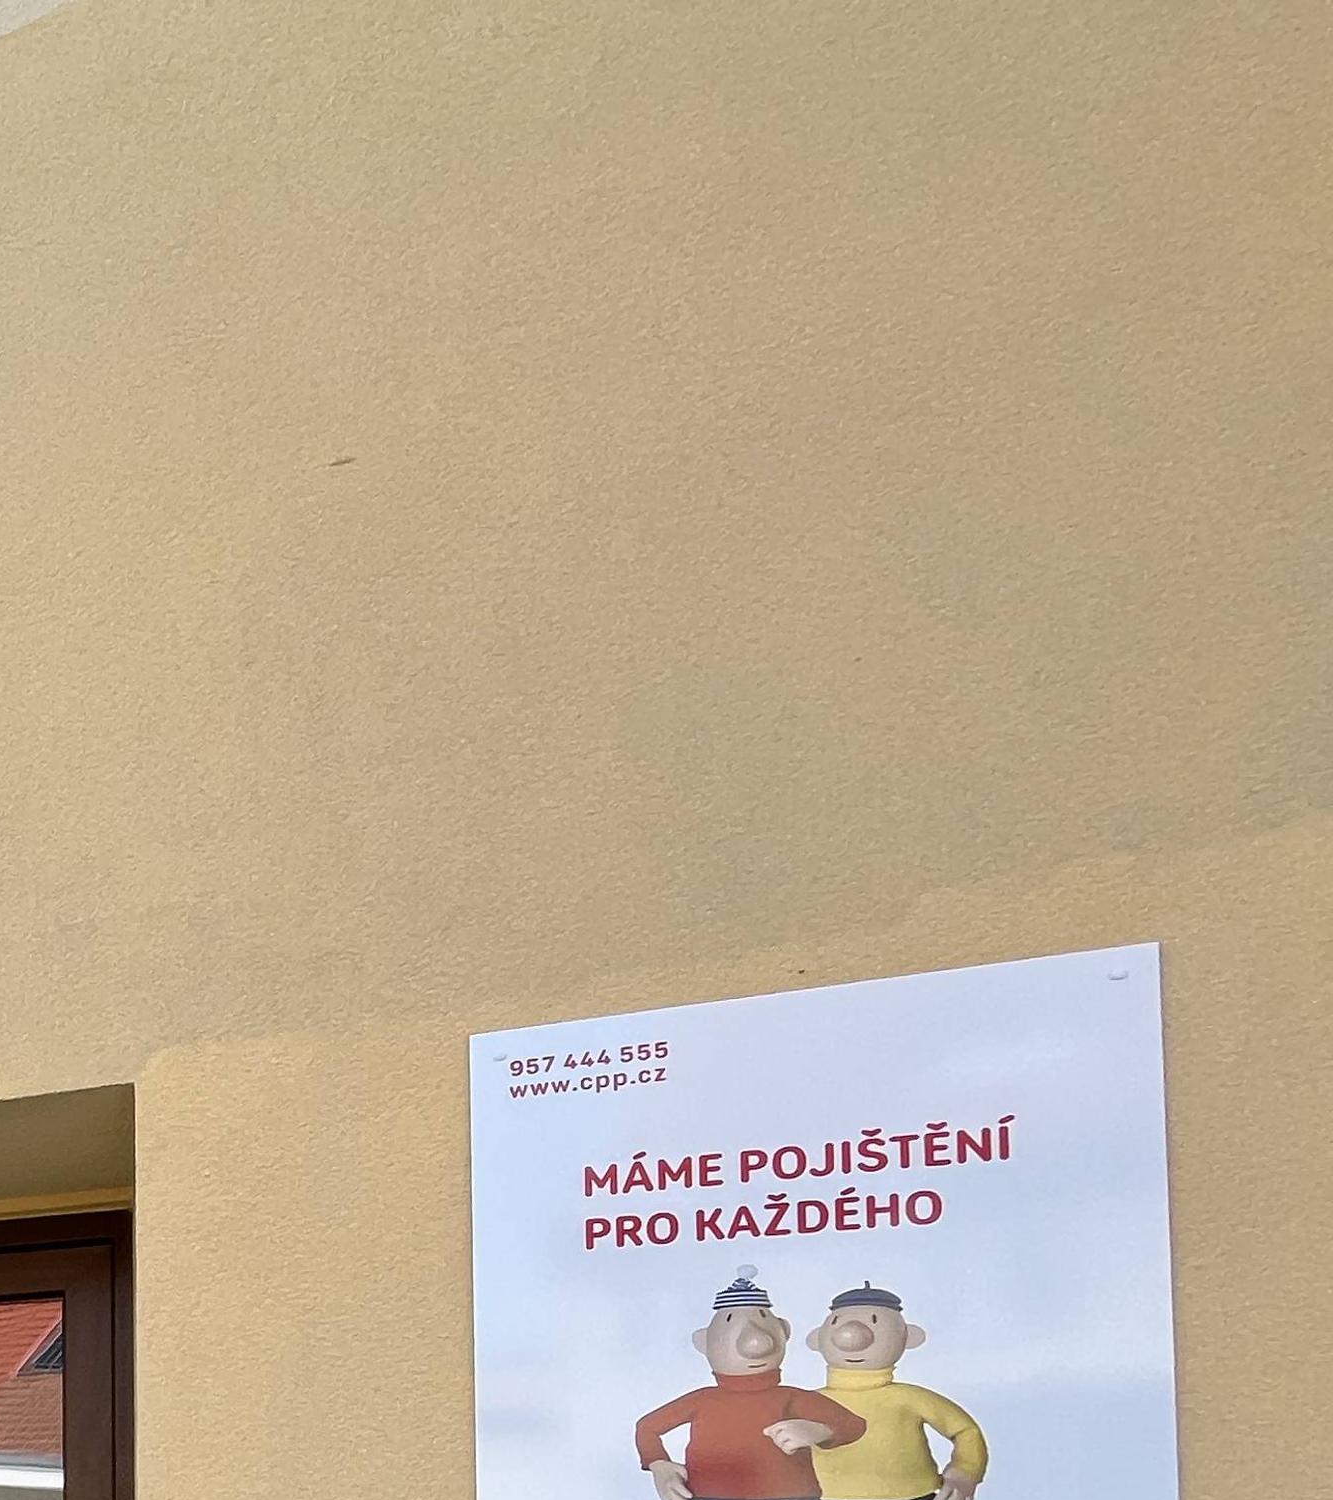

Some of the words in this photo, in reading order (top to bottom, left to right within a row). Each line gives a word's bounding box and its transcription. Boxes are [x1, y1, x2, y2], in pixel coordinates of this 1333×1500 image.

[510, 1056, 555, 1076] 957
[564, 1049, 611, 1069] 444
[620, 1041, 669, 1063] 555
[510, 1067, 667, 1098] www.cpp.cz
[583, 1151, 724, 1198] MÁME
[740, 1114, 1016, 1183] POJIŠTĚNÍ
[584, 1211, 679, 1250] PRO
[695, 1187, 944, 1242] KAŽDÉHO
